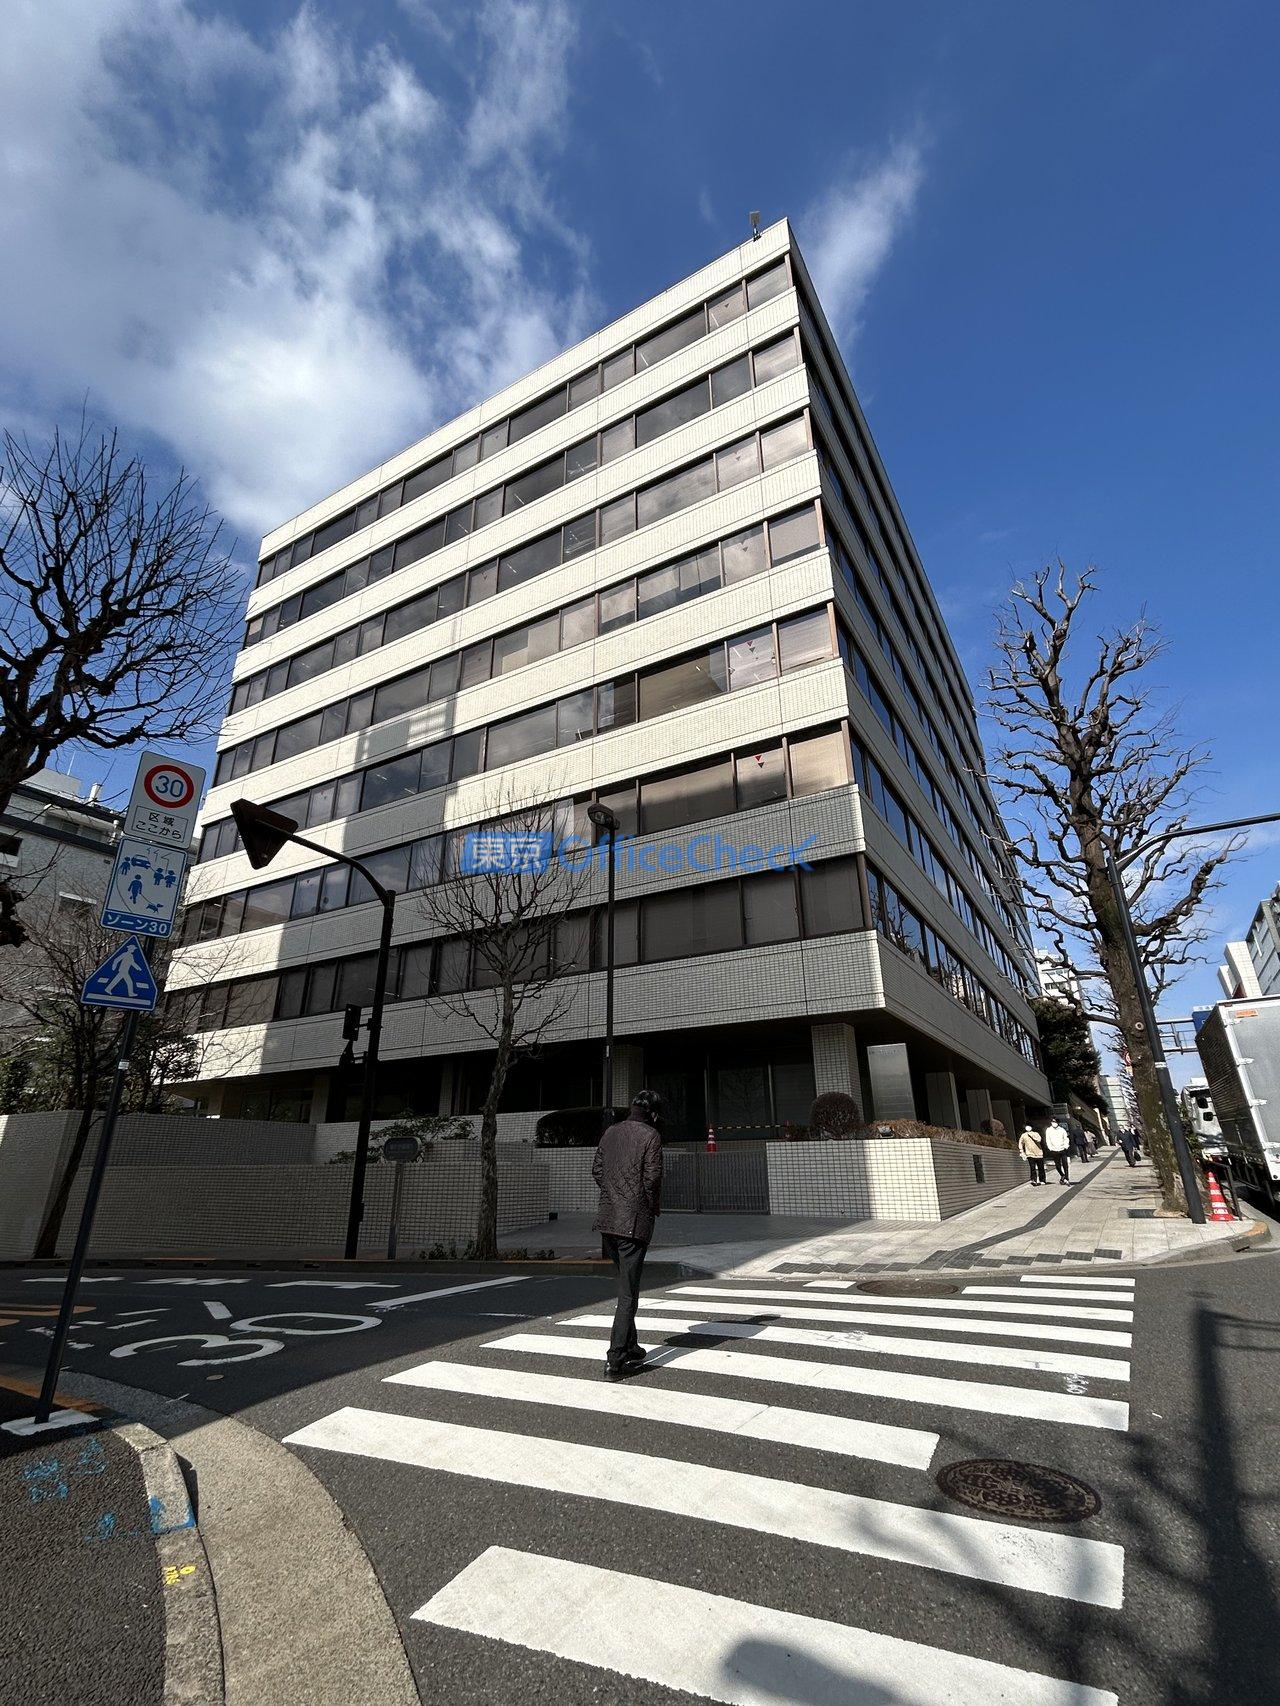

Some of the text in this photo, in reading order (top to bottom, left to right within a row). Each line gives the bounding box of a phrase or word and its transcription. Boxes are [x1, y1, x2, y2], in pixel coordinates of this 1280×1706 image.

[155, 775, 184, 798] 30
[148, 812, 175, 827] 区域
[135, 820, 182, 840] ここから
[106, 914, 168, 934] ゾーン30
[109, 1312, 382, 1366] 30
